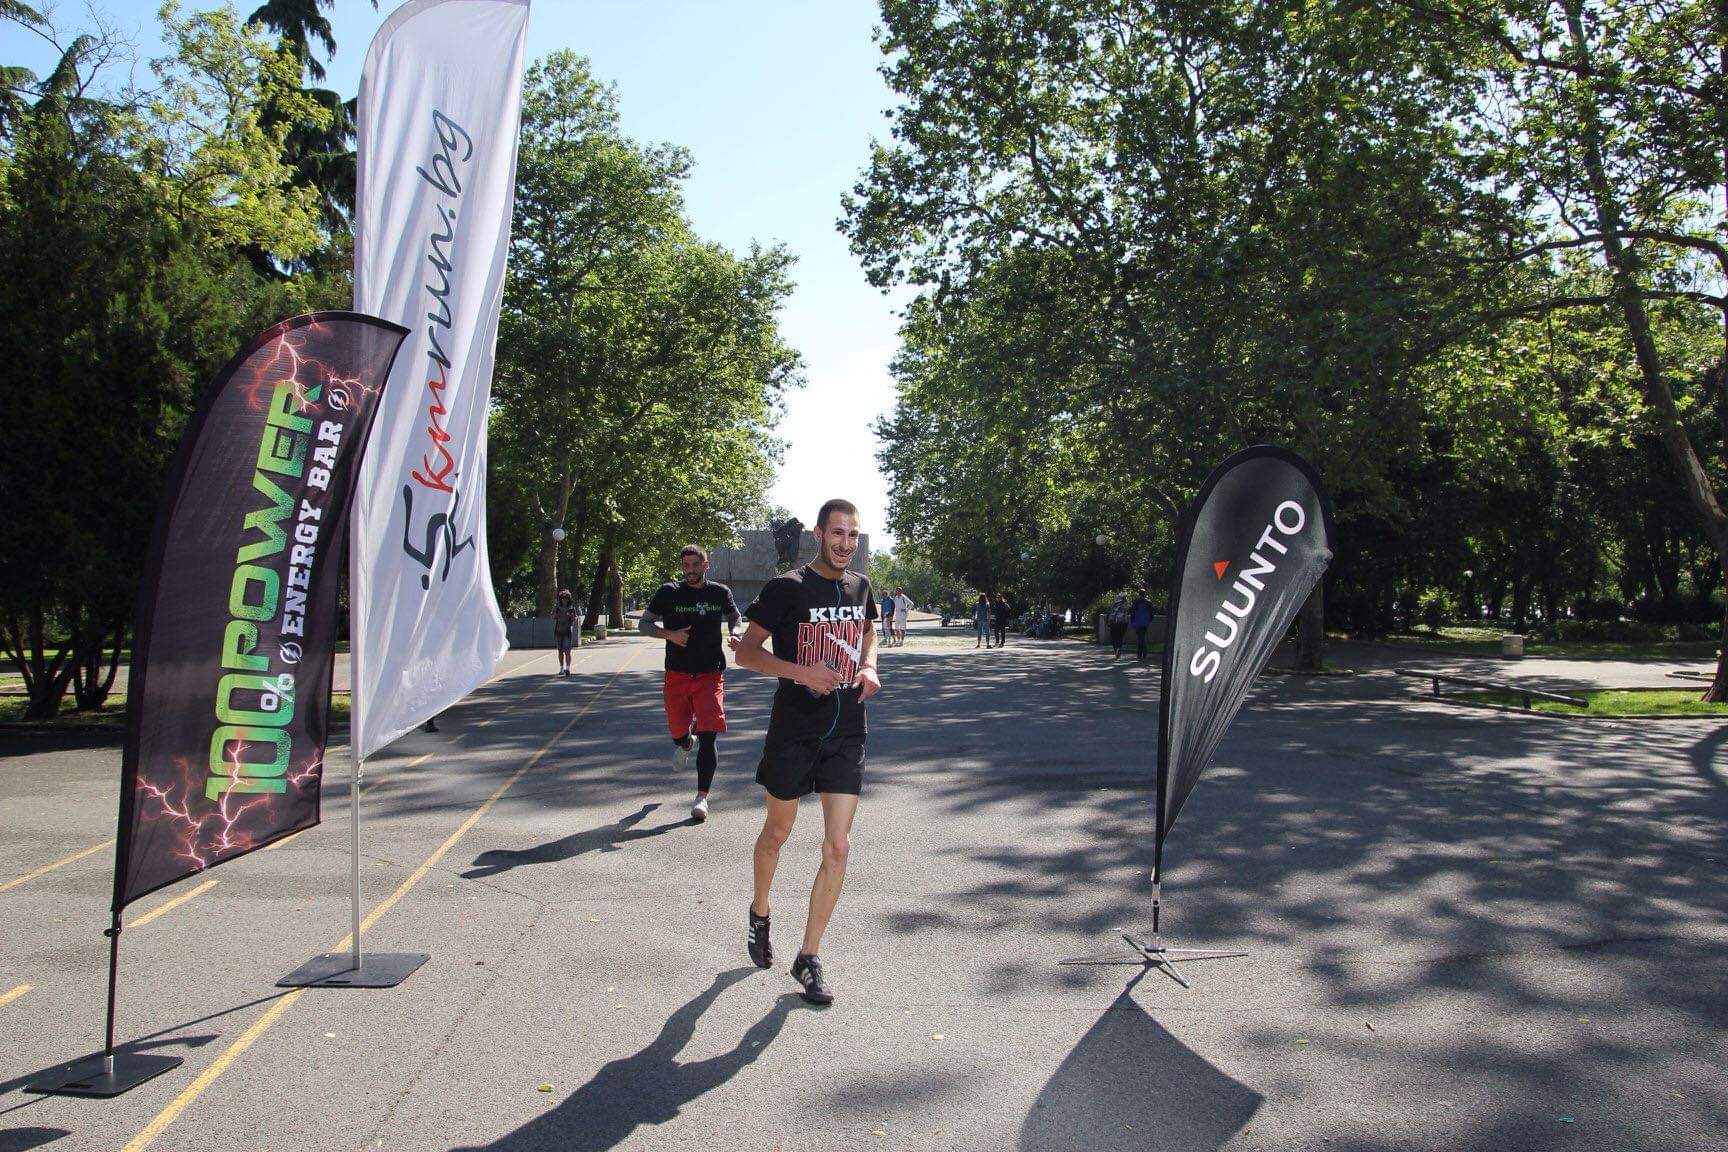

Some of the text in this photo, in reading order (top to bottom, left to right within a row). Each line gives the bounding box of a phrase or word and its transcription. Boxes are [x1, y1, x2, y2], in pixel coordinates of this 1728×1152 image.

[280, 420, 344, 637] ENERGY BAR
[797, 621, 865, 683] BOXIN
[809, 605, 866, 623] KICK
[1189, 500, 1306, 684] SUUNTO
